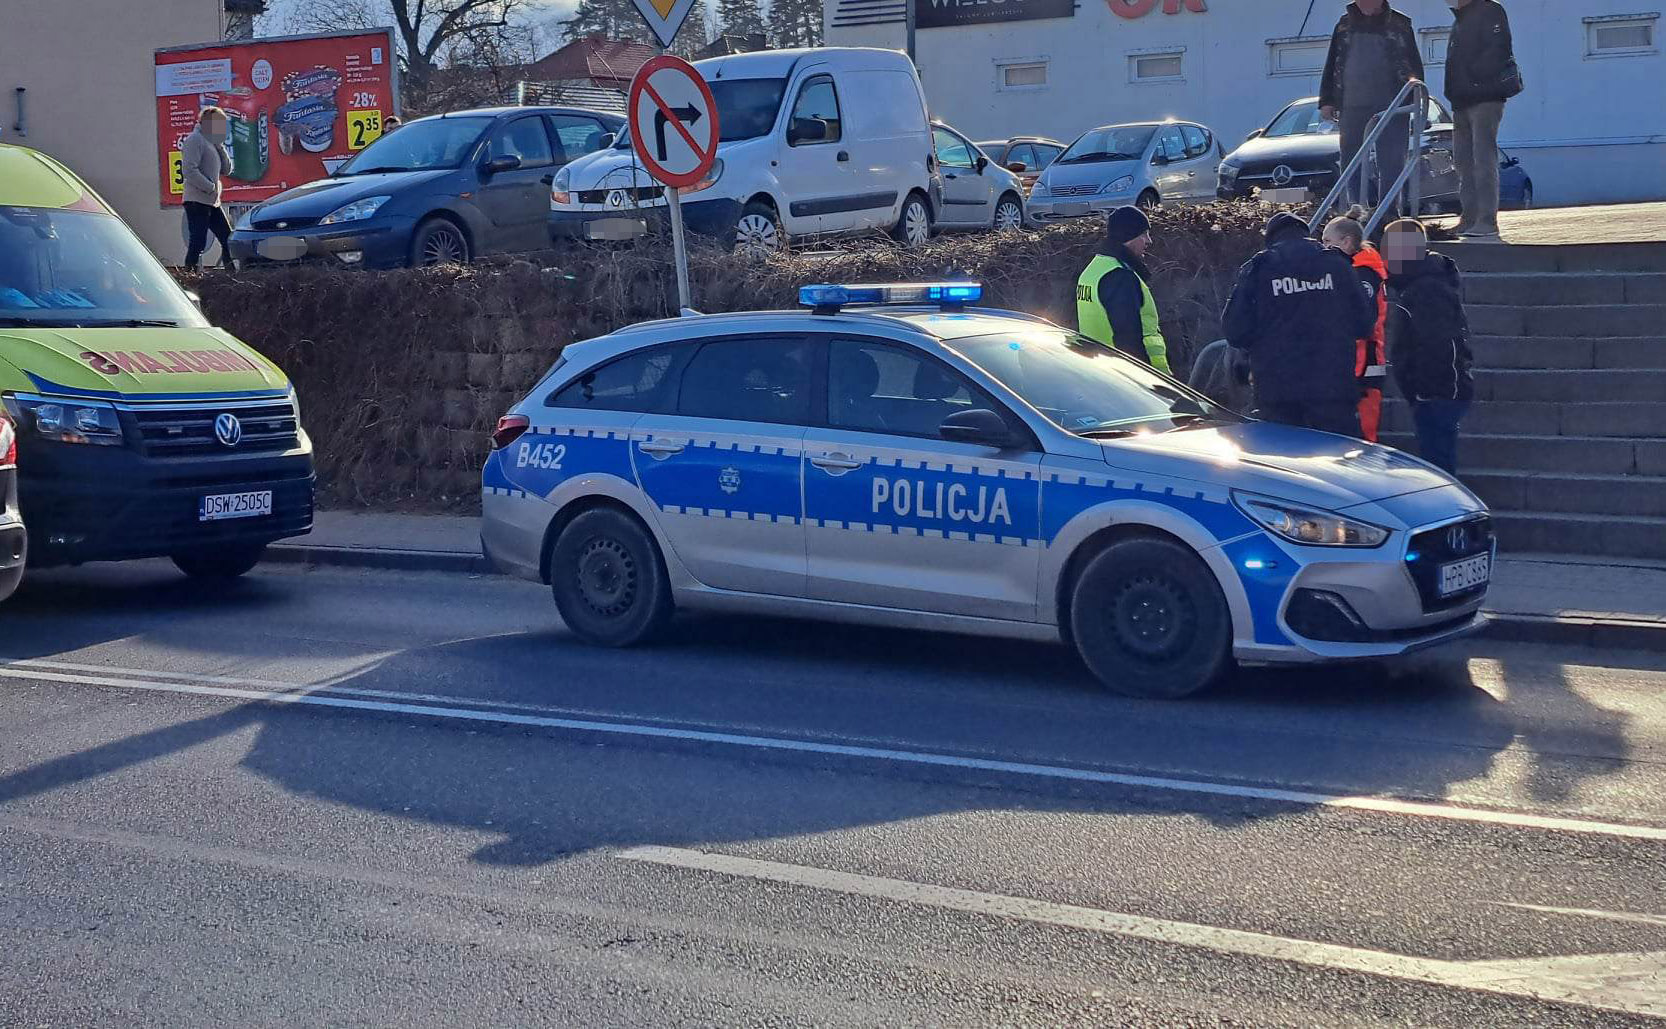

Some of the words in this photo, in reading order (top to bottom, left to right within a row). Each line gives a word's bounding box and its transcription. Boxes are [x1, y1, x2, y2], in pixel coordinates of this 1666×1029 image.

[349, 92, 377, 107] -28%
[516, 442, 566, 470] B452
[872, 477, 1012, 525] POLICJA
